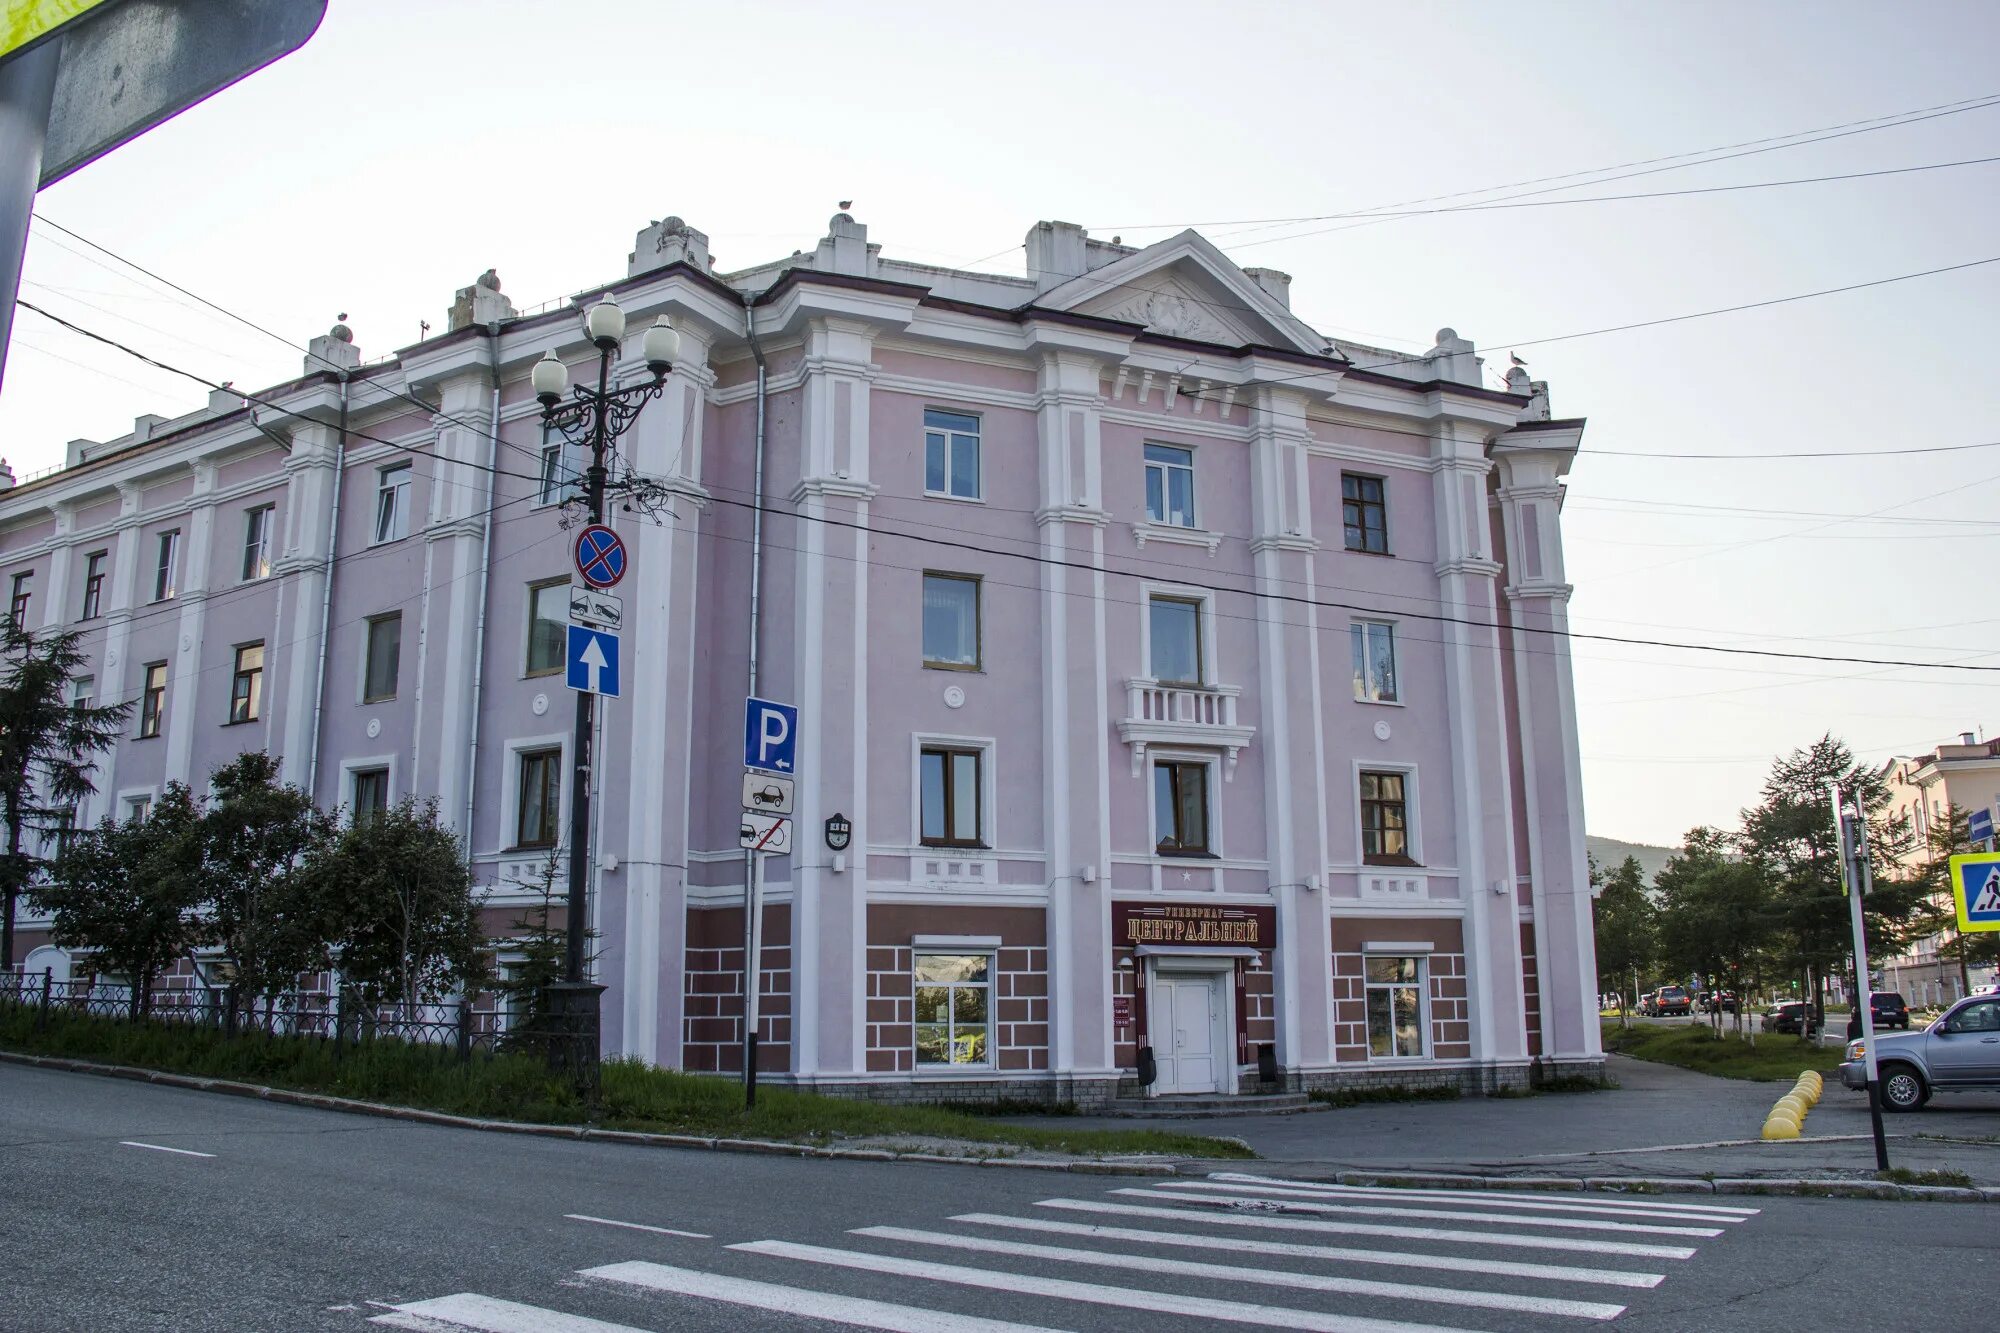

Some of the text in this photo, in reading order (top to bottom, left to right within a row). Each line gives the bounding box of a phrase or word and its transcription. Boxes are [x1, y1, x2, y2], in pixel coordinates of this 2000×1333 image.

[759, 708, 788, 761] P
[1165, 906, 1224, 918] УНИВЕРМАГ
[1128, 918, 1258, 944] ЦЕНТРАЛЬНЫЙ
